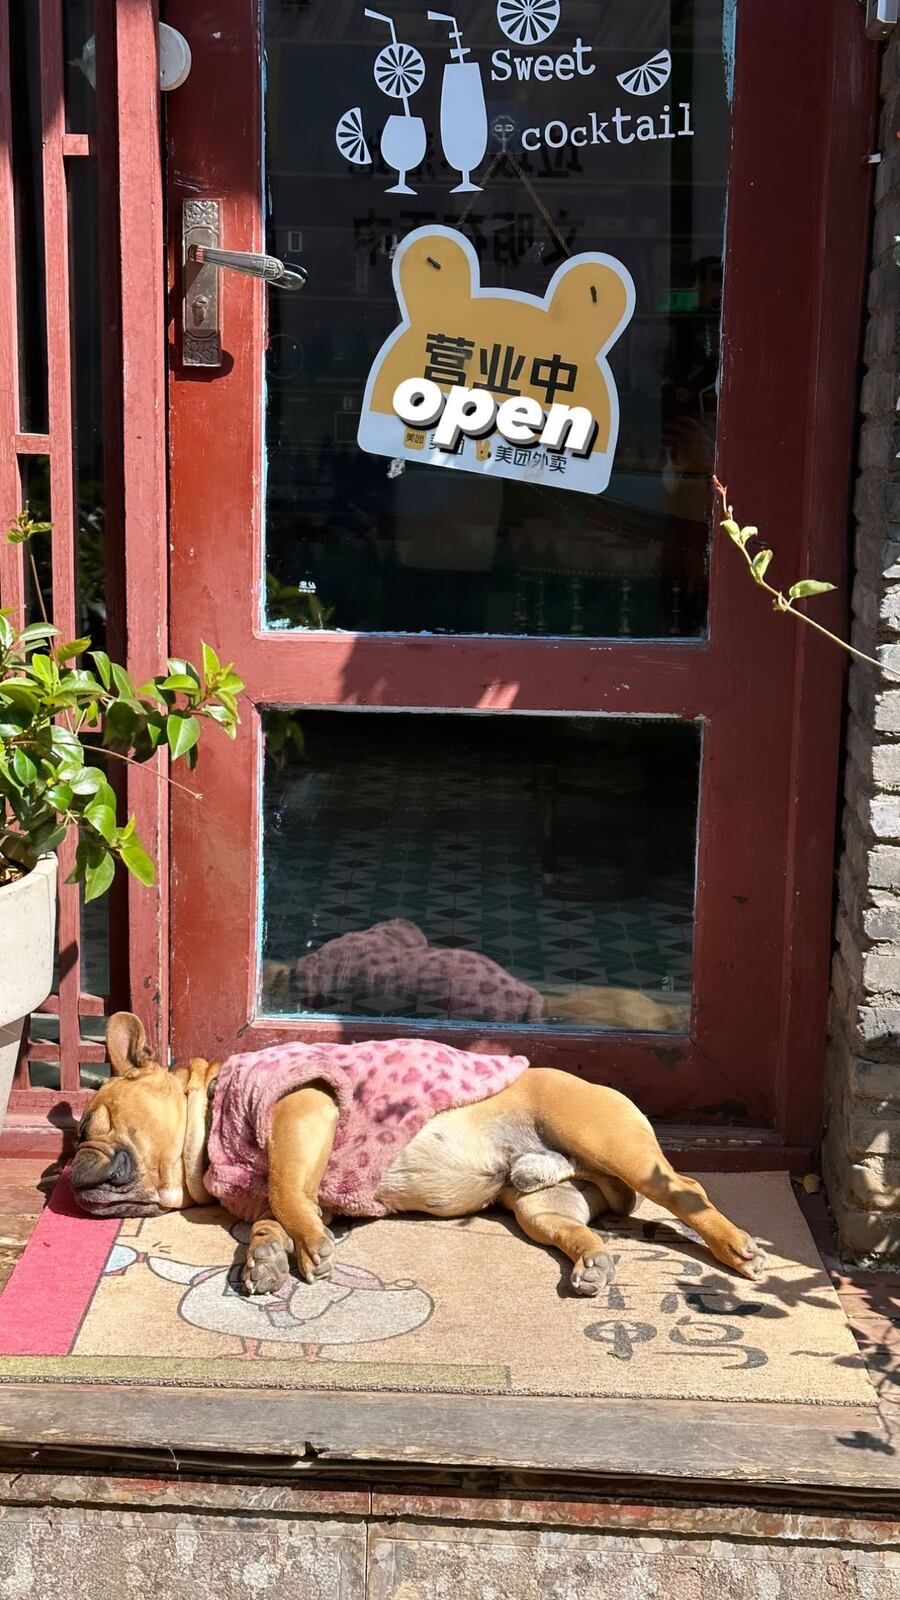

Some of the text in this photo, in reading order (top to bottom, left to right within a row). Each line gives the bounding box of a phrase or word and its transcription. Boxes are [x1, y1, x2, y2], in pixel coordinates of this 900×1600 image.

[490, 38, 596, 82] Sweet
[424, 333, 578, 403] 营业中
[495, 445, 568, 474] 美团外卖
